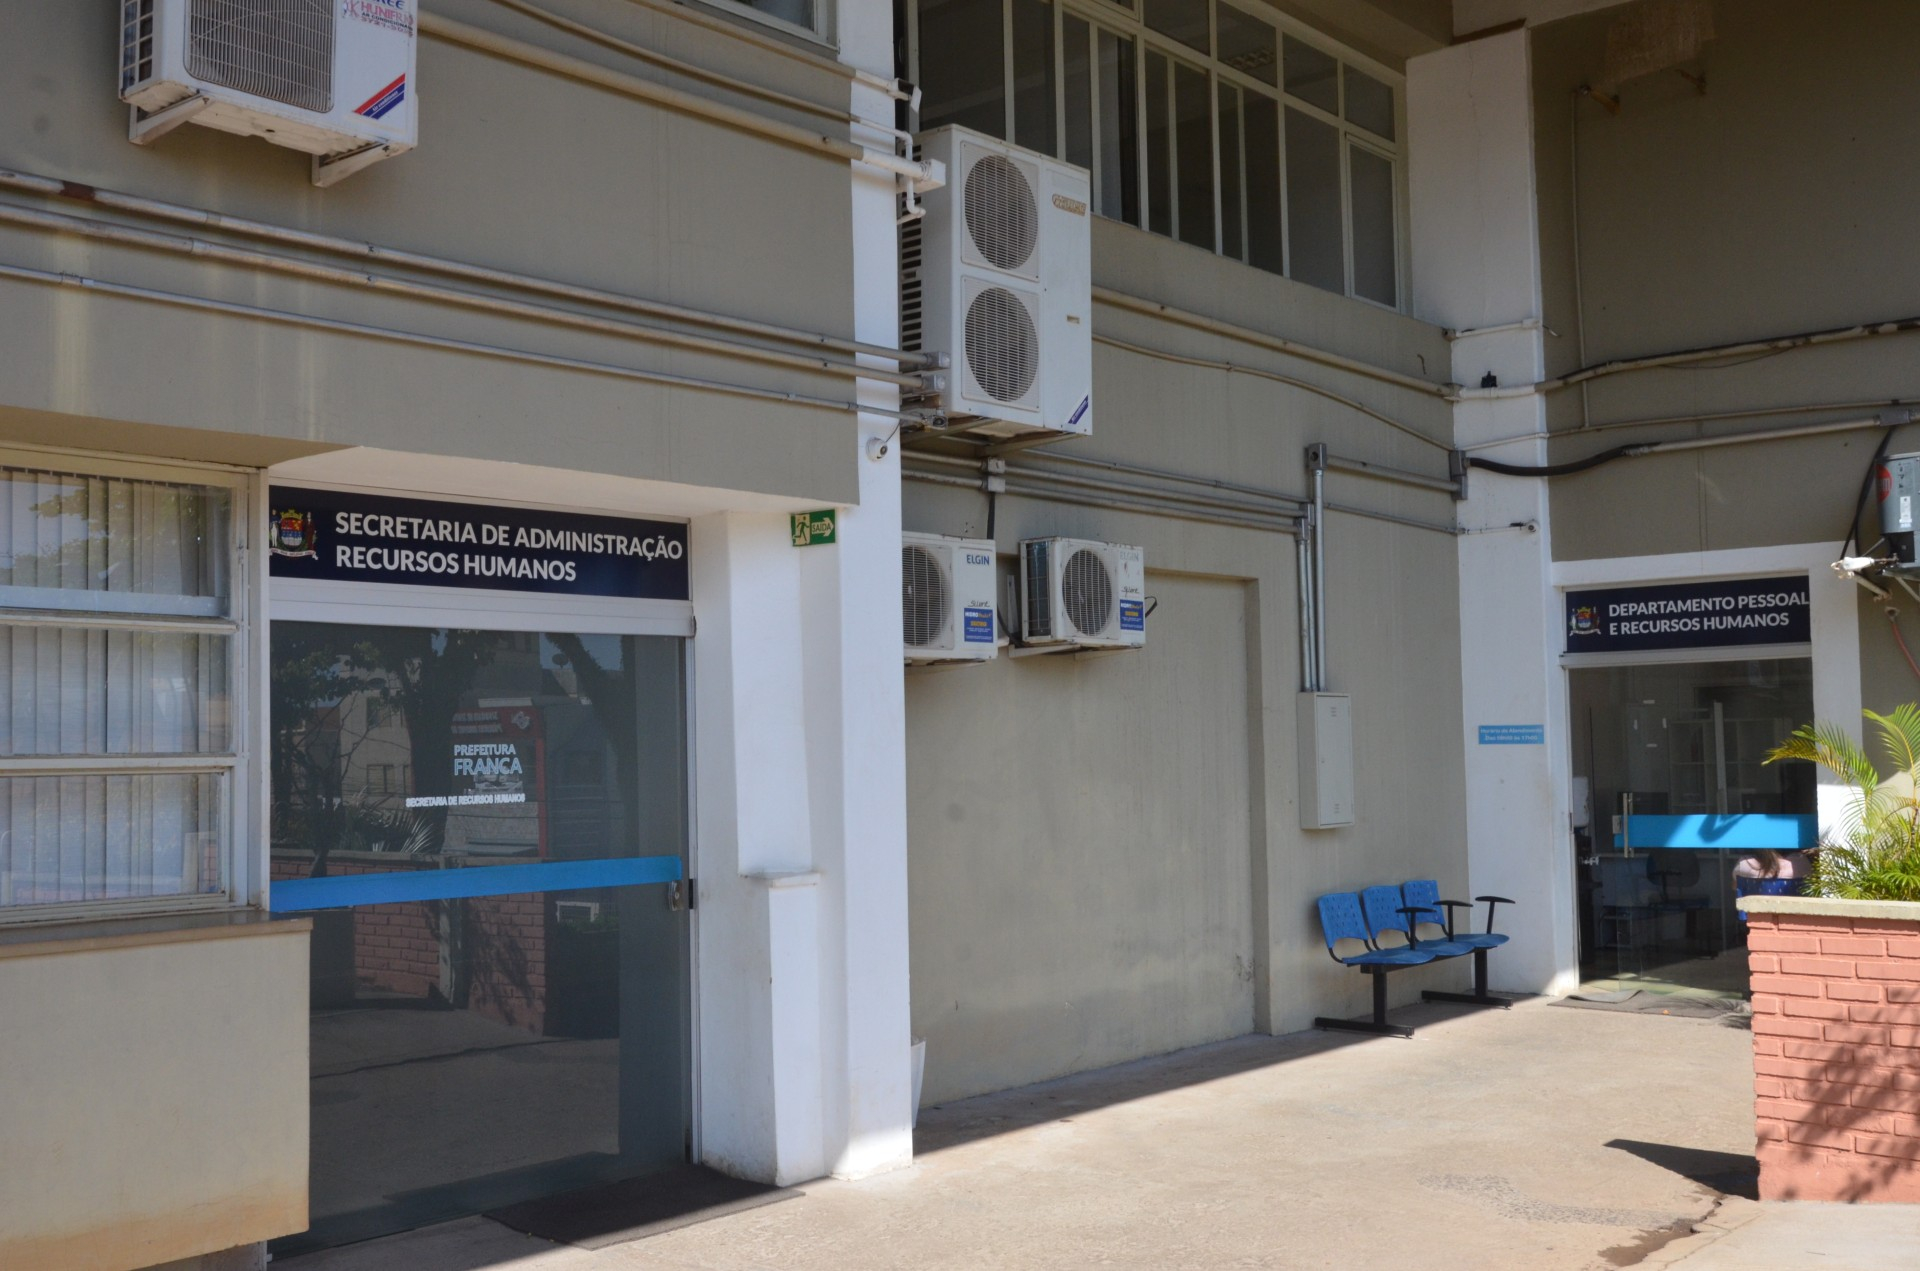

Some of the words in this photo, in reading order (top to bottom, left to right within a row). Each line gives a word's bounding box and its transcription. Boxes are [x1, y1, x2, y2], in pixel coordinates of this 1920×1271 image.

[335, 512, 477, 544] SECRETARIA
[482, 524, 510, 546] DE
[514, 527, 683, 561] ADMINISTRAÇÃO
[336, 545, 459, 574] RECURSOS
[464, 554, 576, 582] HUMANOS
[966, 554, 990, 566] ELGIN
[1608, 596, 1735, 617] DEPARTAMENTO
[1738, 592, 1810, 609] PESSOAL
[1609, 622, 1618, 636] E
[1621, 618, 1700, 635] RECURSOS
[1703, 612, 1790, 631] HUMANOS
[454, 744, 516, 756] PREFEITURA
[454, 757, 523, 776] FRANCA
[405, 796, 447, 808] SECRETARIA
[448, 794, 458, 806] DE
[458, 793, 493, 806] RECURSOS
[494, 792, 526, 804] HUMANOS
